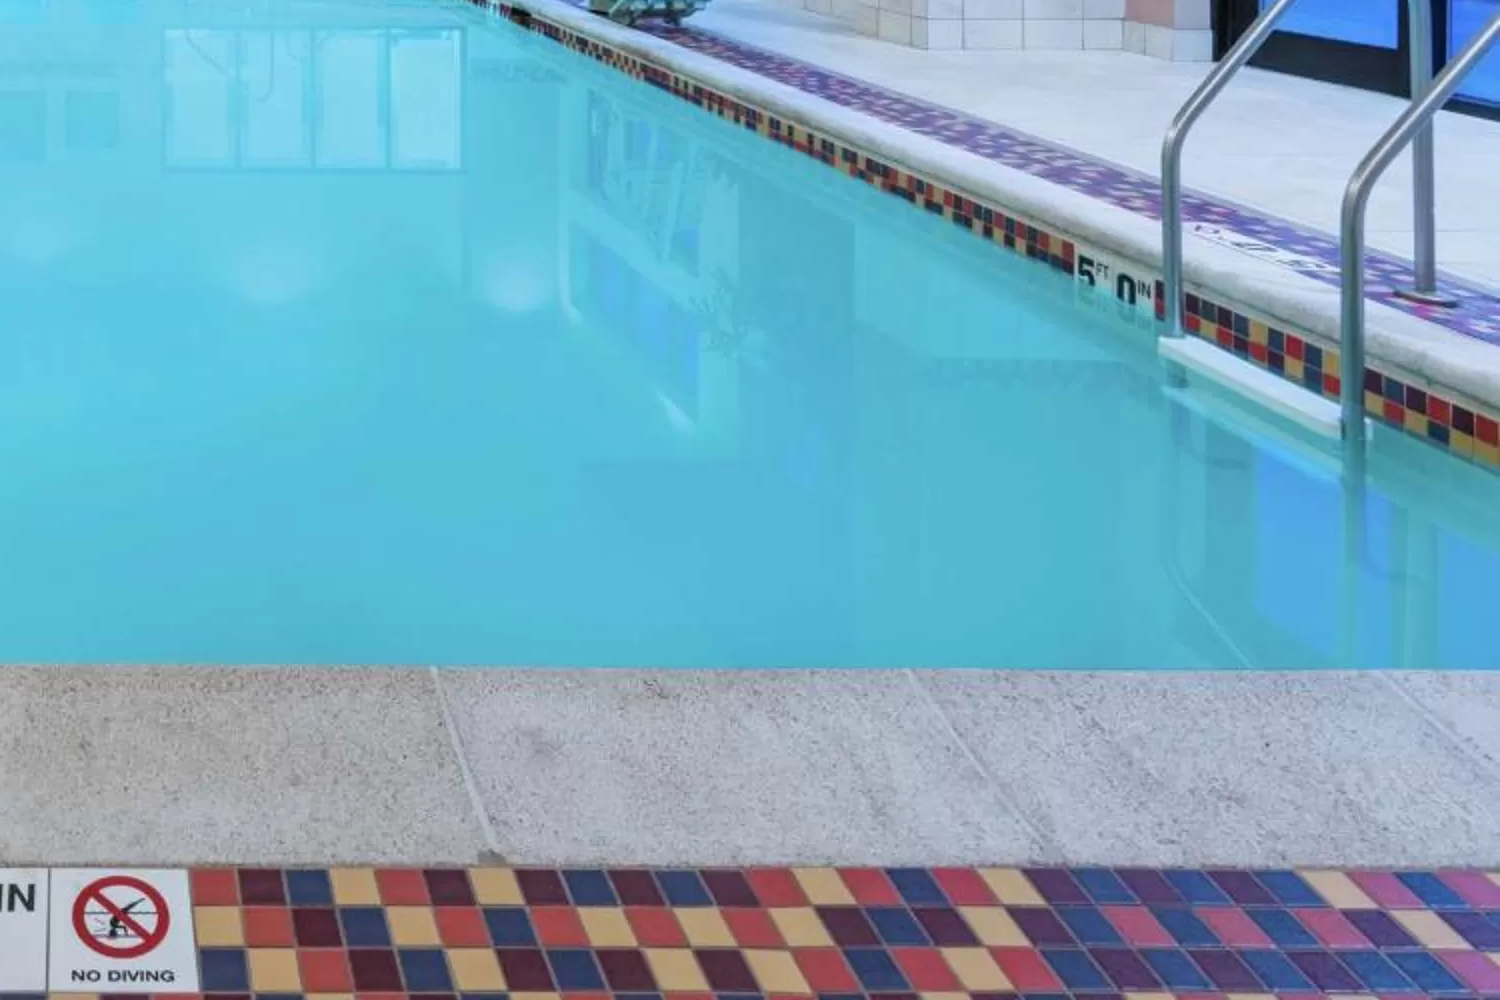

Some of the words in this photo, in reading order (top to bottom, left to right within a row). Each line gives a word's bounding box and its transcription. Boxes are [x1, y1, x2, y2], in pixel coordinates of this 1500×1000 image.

[1078, 254, 1095, 287] 5
[1137, 279, 1151, 299] IN
[71, 970, 101, 983] NO
[108, 970, 176, 983] DIVING
